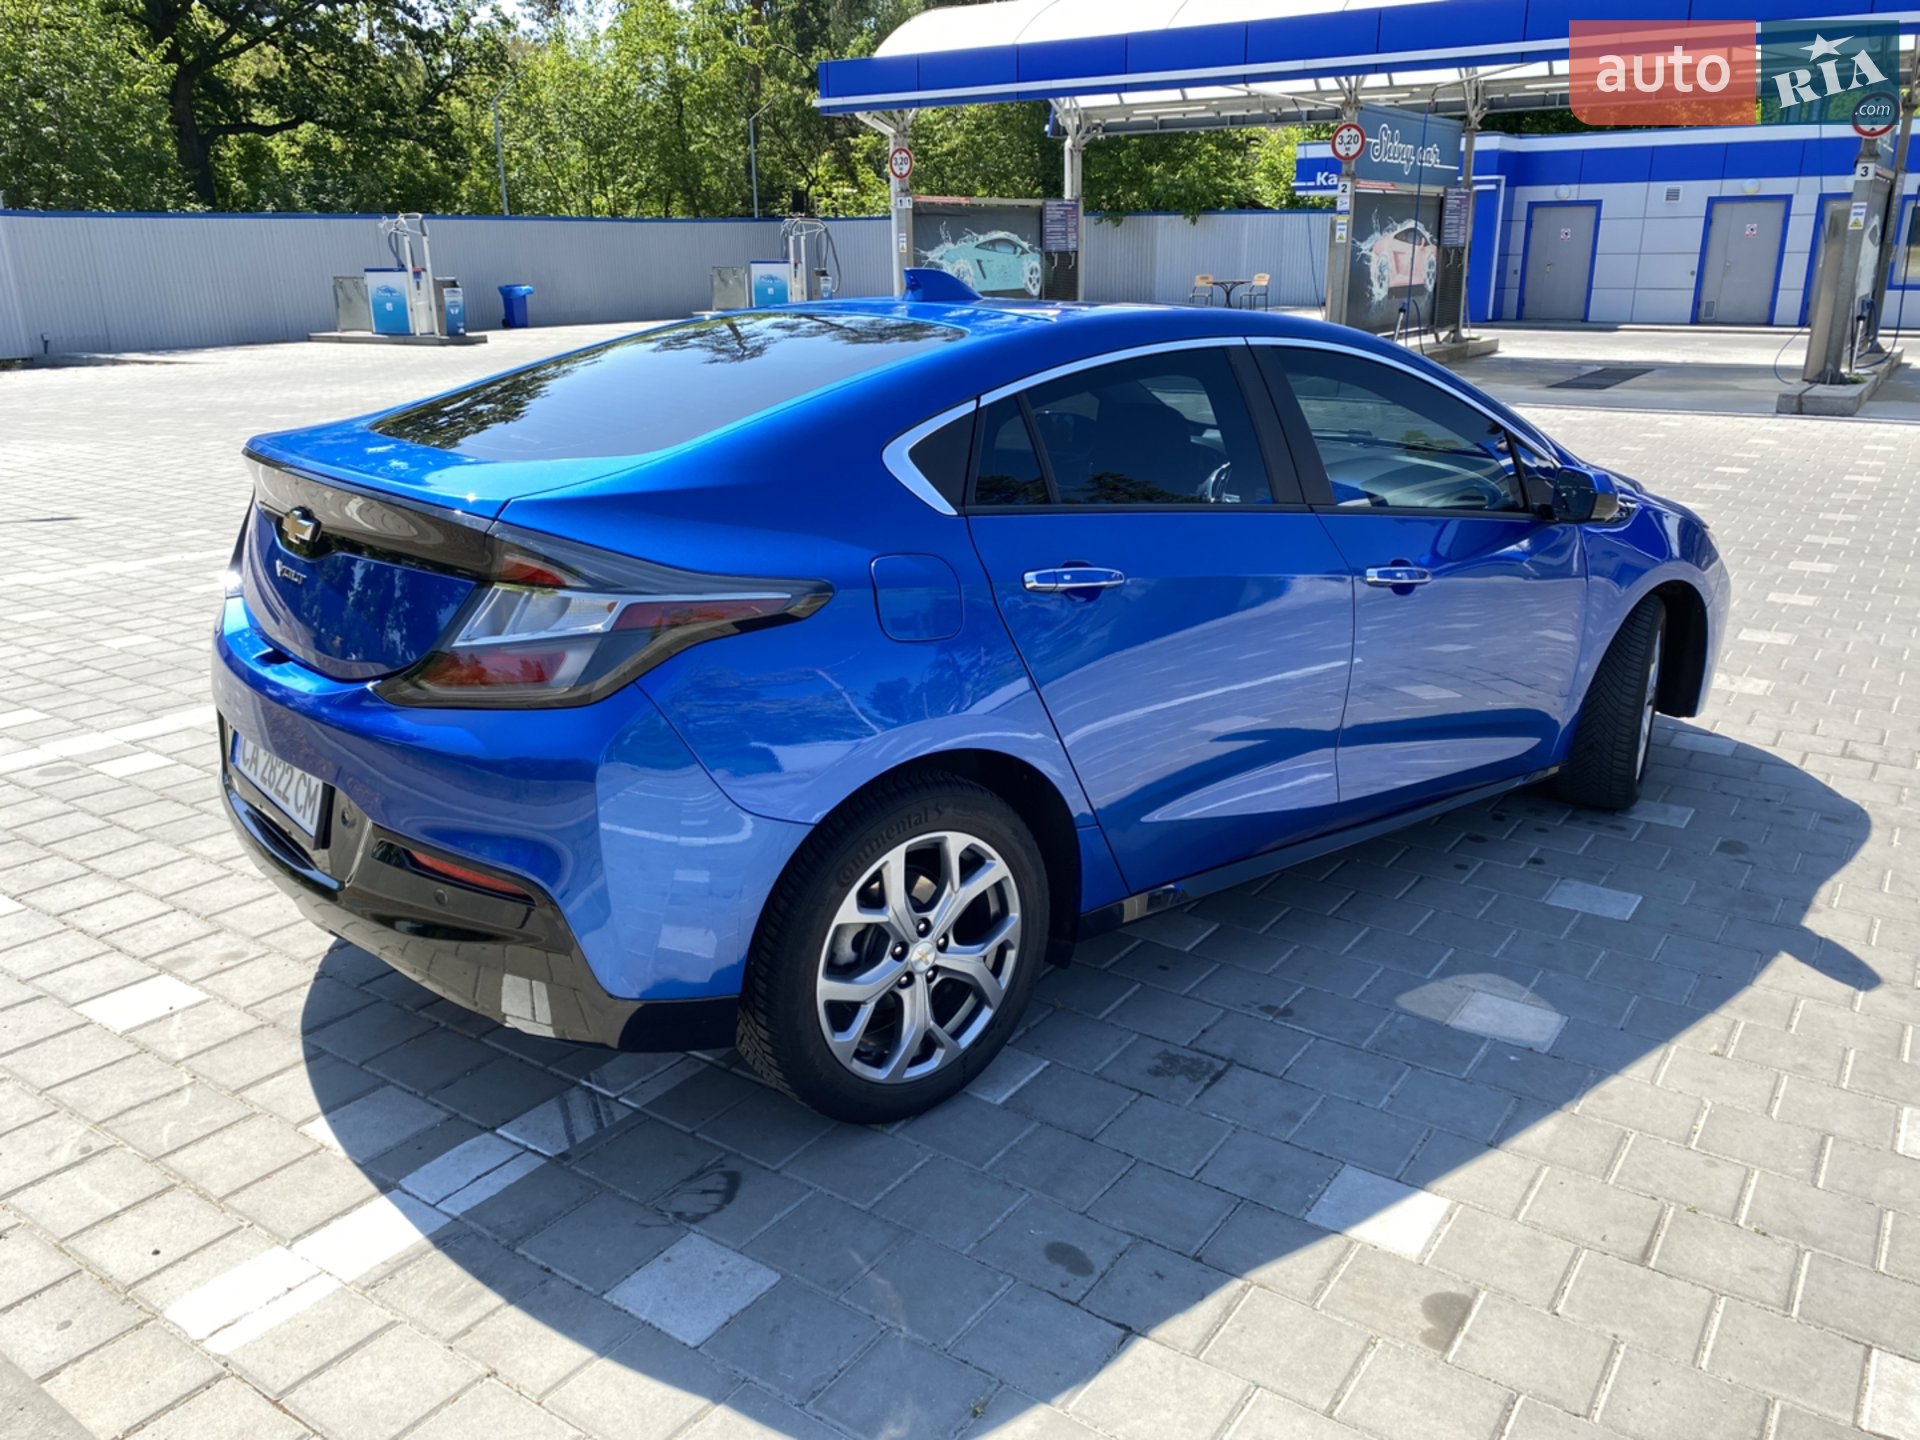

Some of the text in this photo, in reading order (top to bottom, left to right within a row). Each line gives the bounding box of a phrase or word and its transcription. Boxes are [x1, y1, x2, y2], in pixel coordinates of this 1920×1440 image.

[1337, 133, 1360, 147] 3,20
[1859, 165, 1869, 178] 3
[1341, 183, 1348, 193] 2
[242, 738, 320, 826] CA 2822 CM
[836, 806, 930, 888] Continental
